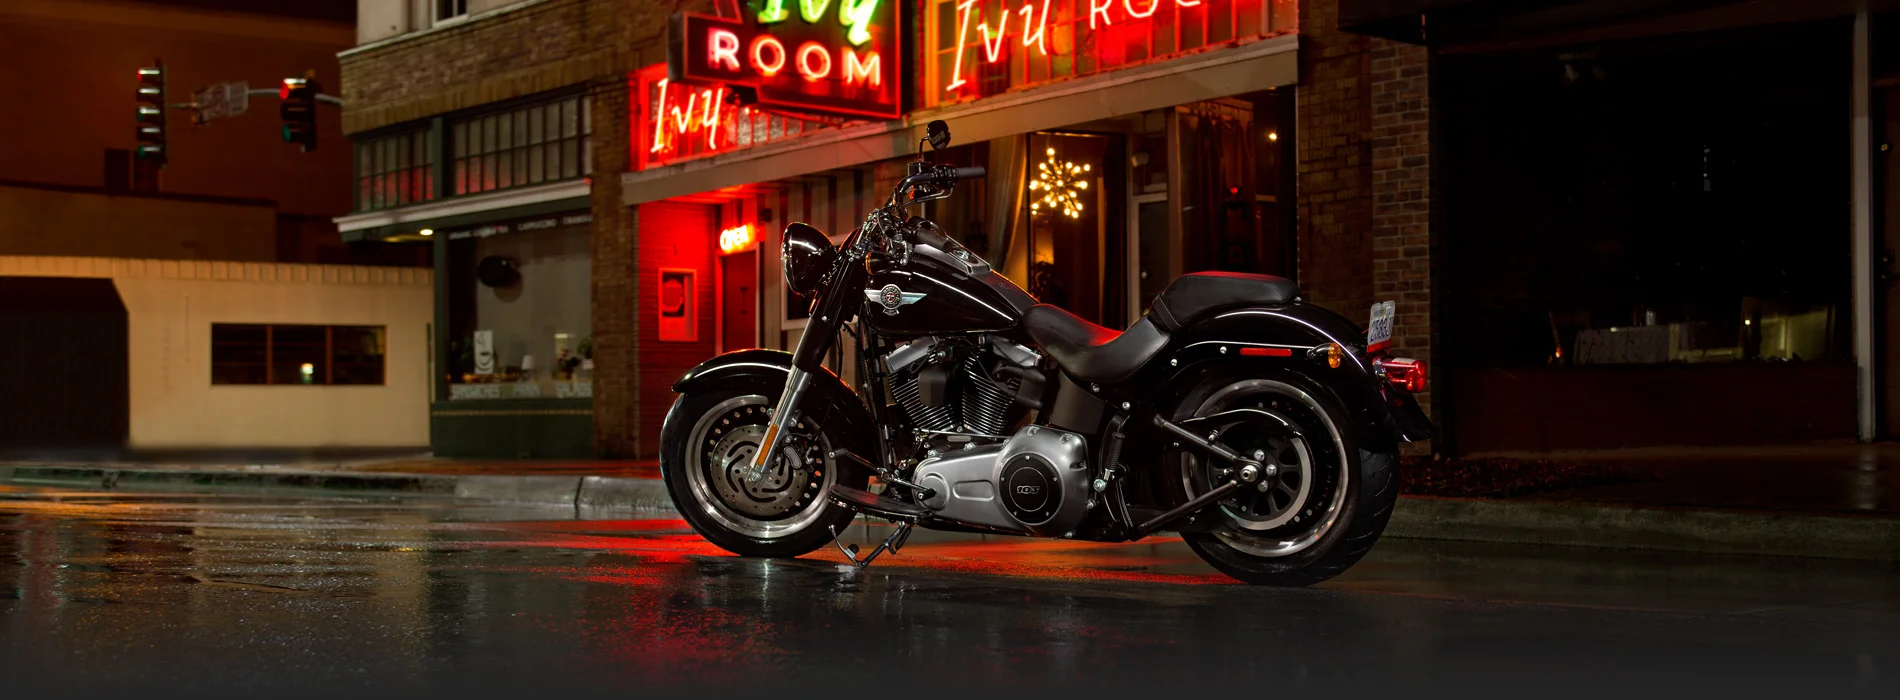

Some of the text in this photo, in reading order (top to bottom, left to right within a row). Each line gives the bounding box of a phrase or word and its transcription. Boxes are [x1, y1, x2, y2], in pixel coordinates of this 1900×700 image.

[707, 27, 881, 87] ROOM
[946, 0, 1048, 91] Ivy
[650, 78, 724, 153] Ivy
[719, 223, 751, 251] OPEN
